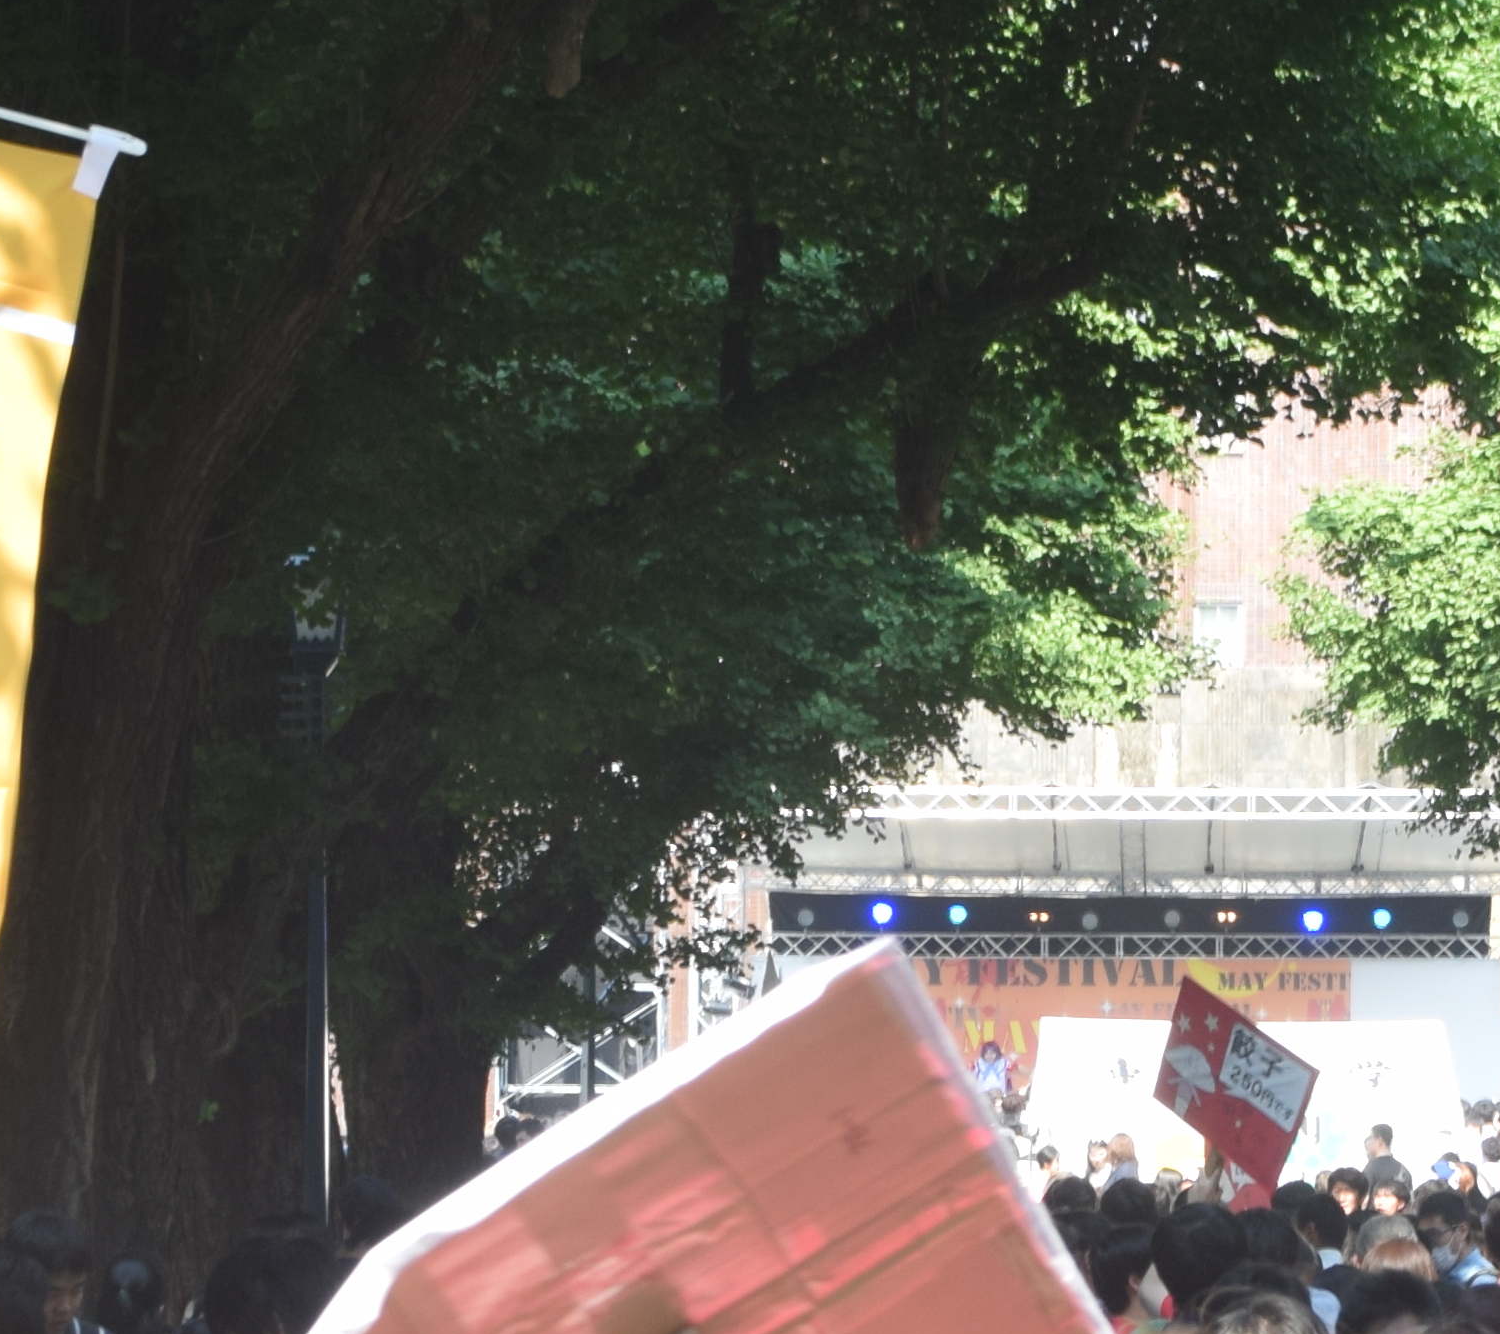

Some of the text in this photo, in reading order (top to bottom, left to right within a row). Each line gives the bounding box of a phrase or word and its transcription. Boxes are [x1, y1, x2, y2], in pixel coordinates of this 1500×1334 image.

[1218, 972, 1268, 991] MAY
[964, 1019, 1040, 1054] MA
[1229, 1027, 1284, 1079] 餃子
